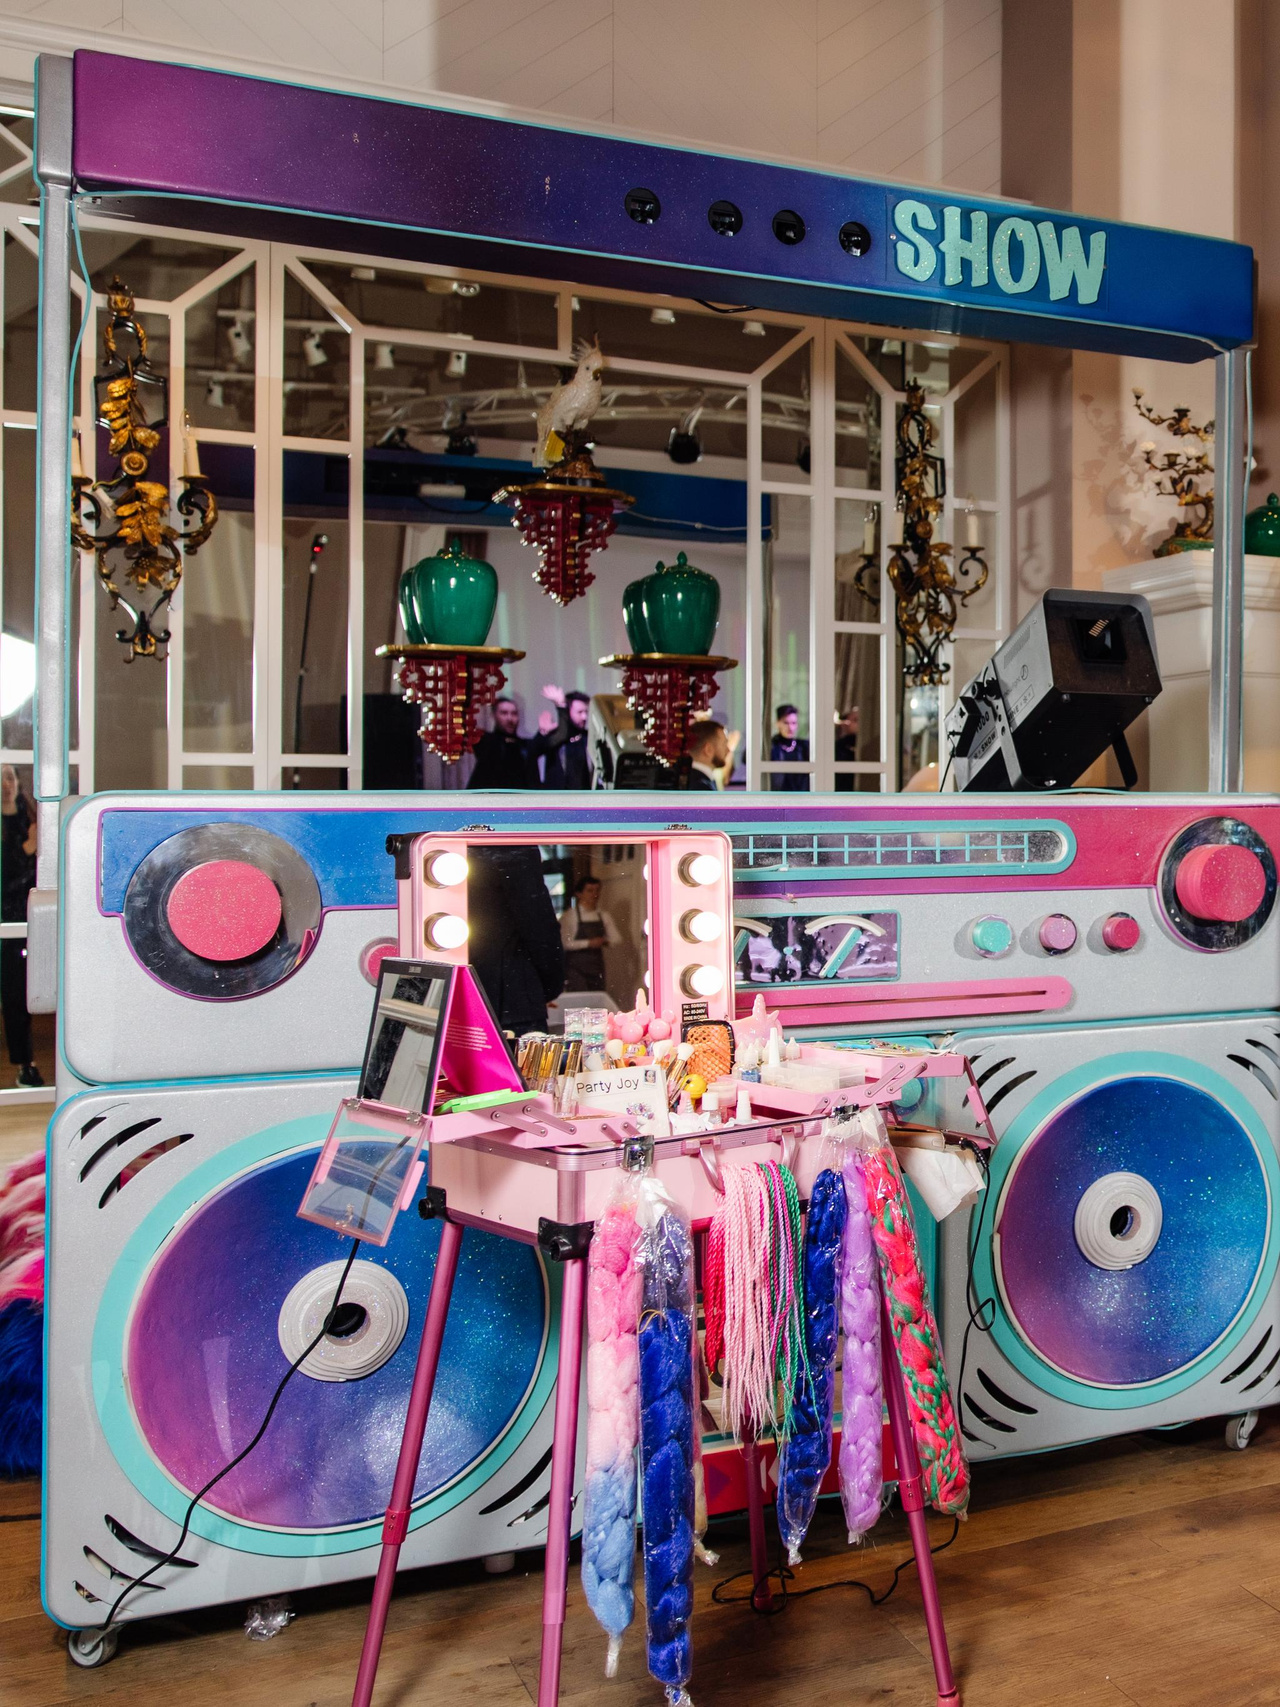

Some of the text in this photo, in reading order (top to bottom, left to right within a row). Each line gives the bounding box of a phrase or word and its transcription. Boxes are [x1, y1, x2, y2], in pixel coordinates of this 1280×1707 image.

[894, 199, 1107, 305] SHOW
[981, 731, 996, 752] SNOW
[576, 1078, 639, 1094] Party Joy
